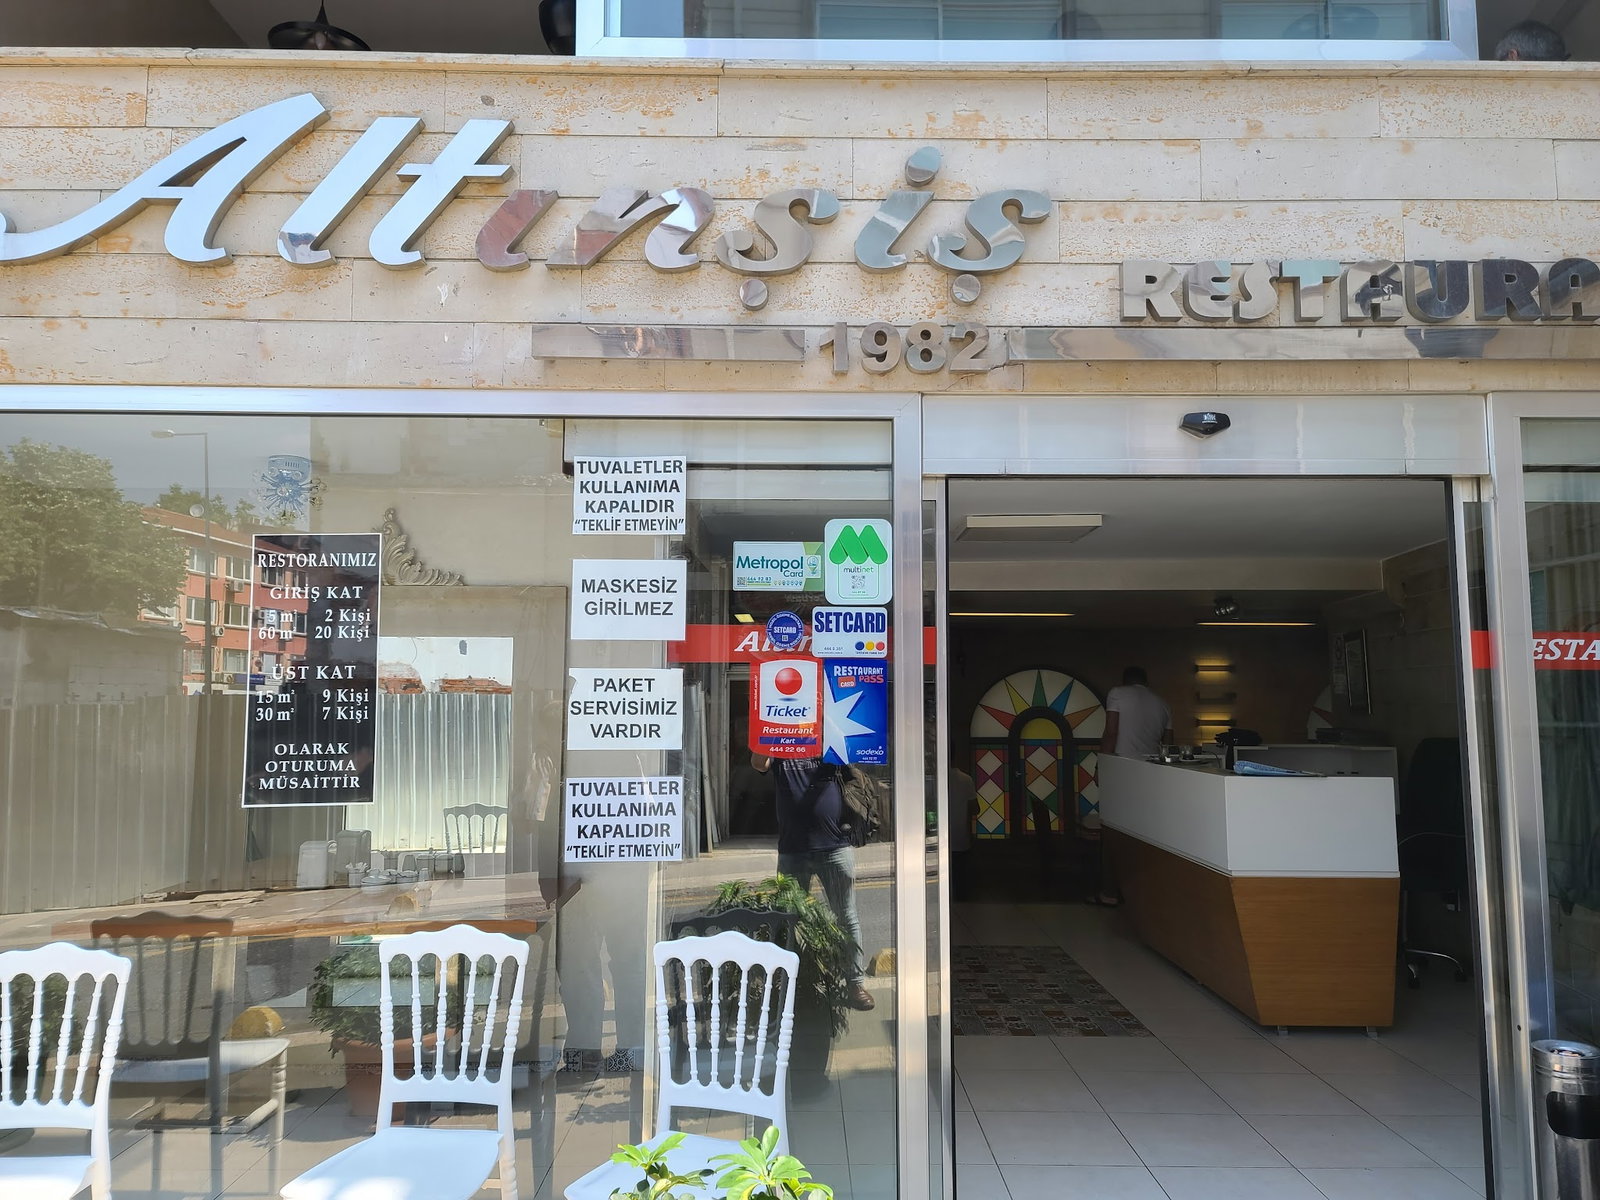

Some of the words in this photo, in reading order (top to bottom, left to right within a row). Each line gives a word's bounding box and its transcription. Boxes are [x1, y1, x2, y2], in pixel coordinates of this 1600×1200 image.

[819, 321, 990, 375] 1982
[576, 459, 683, 475] TUVALETLER
[579, 479, 680, 494] KULLANIMA
[585, 499, 675, 514] KAPALIDIR
[257, 553, 377, 568] RESTORANIMIZ
[736, 555, 804, 572] Metropol
[269, 584, 321, 602] GİRİŞ
[326, 586, 364, 599] KAT
[581, 576, 678, 594] MASKESİZ
[584, 598, 674, 616] GİRİLMEZ
[268, 610, 277, 622] 5
[324, 609, 334, 622] 2
[339, 608, 372, 625] Kişi
[814, 611, 886, 633] SETCARD
[258, 627, 276, 639] 60
[314, 626, 333, 639] 20
[337, 625, 371, 642] Kişi
[773, 626, 797, 634] SETCARD
[272, 664, 309, 680] ÜST
[316, 666, 356, 679] KAT
[834, 666, 884, 676] RESTAURANT
[593, 678, 655, 692] PAKET
[256, 690, 273, 704] 15
[323, 689, 331, 702] 9
[337, 688, 369, 705] Kişi
[256, 707, 273, 721] 30
[322, 706, 331, 720] 7
[337, 706, 369, 723] Kişi
[570, 697, 678, 716] SERVİSİMİZ
[766, 705, 808, 717] Ticket
[590, 723, 661, 738] VARDIR
[762, 726, 814, 734] Restaurant
[274, 743, 349, 755] OLARAK
[855, 745, 884, 755] sodexo
[265, 760, 357, 773] OTURUMA
[259, 775, 361, 790] MÜSAİTTİR
[569, 781, 680, 797] TUVALETLER
[571, 802, 677, 818] KULLANIMA
[577, 823, 671, 839] KAPALIDIR
